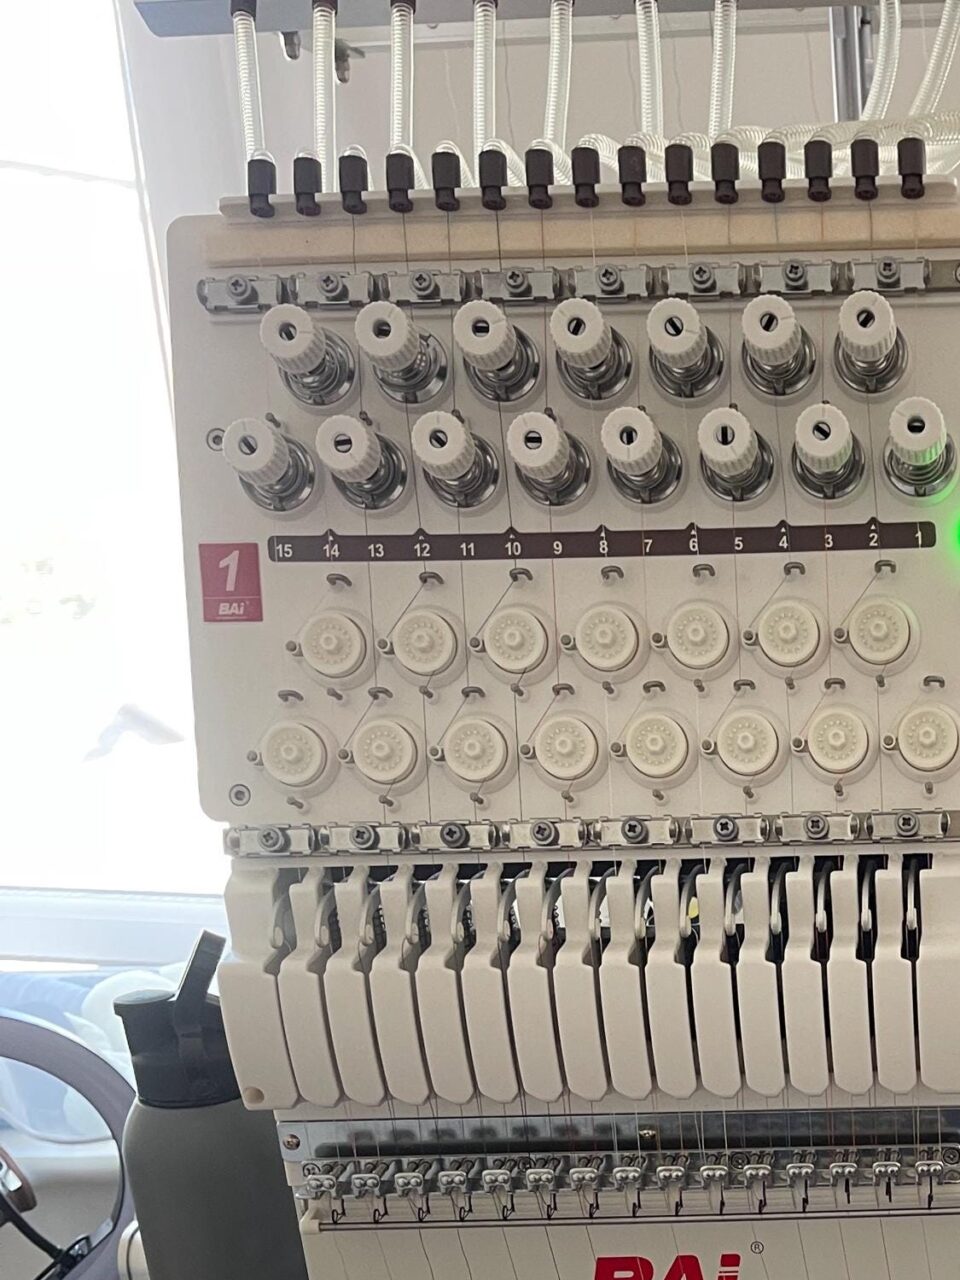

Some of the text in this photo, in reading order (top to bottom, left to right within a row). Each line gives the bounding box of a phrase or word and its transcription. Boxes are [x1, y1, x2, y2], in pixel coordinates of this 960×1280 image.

[276, 531, 923, 557] 15 14 13 12 11 10 9 8 7 6 5 4 3 2 1
[219, 550, 239, 591] 1
[219, 602, 244, 615] BAi
